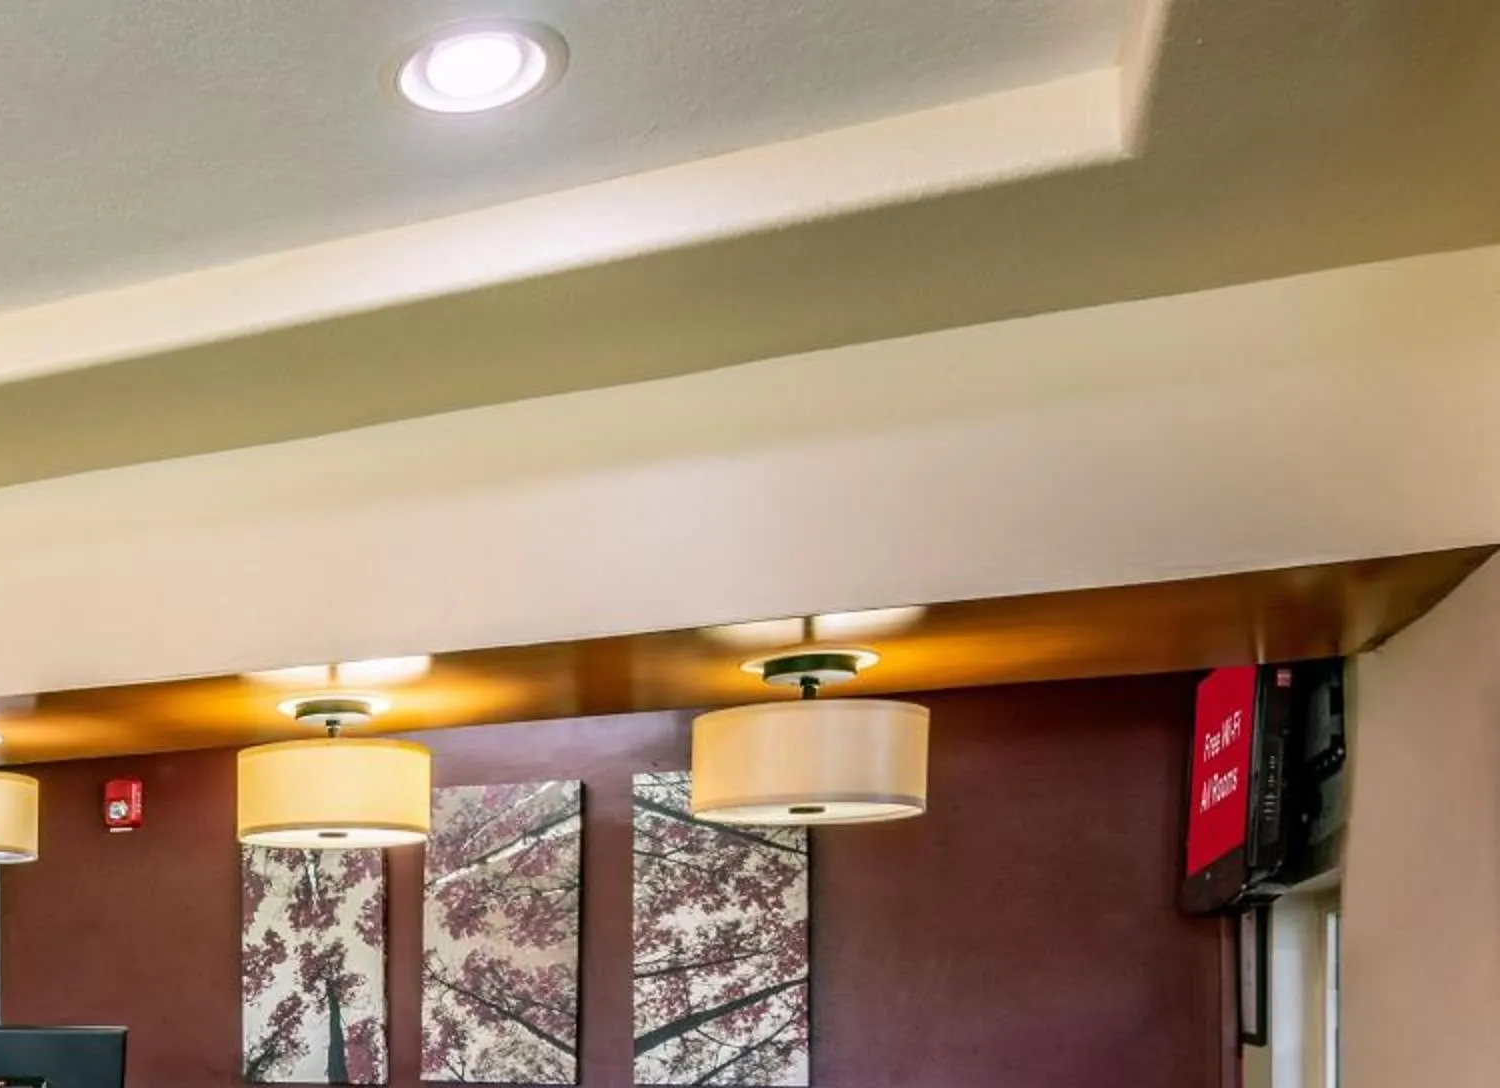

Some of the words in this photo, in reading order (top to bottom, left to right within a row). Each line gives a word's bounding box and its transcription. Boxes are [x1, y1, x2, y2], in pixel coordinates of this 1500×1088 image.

[1203, 733, 1221, 763] Free
[1221, 710, 1242, 749] Wi-Fi
[1199, 780, 1211, 815] All
[1211, 767, 1238, 806] Rooms
